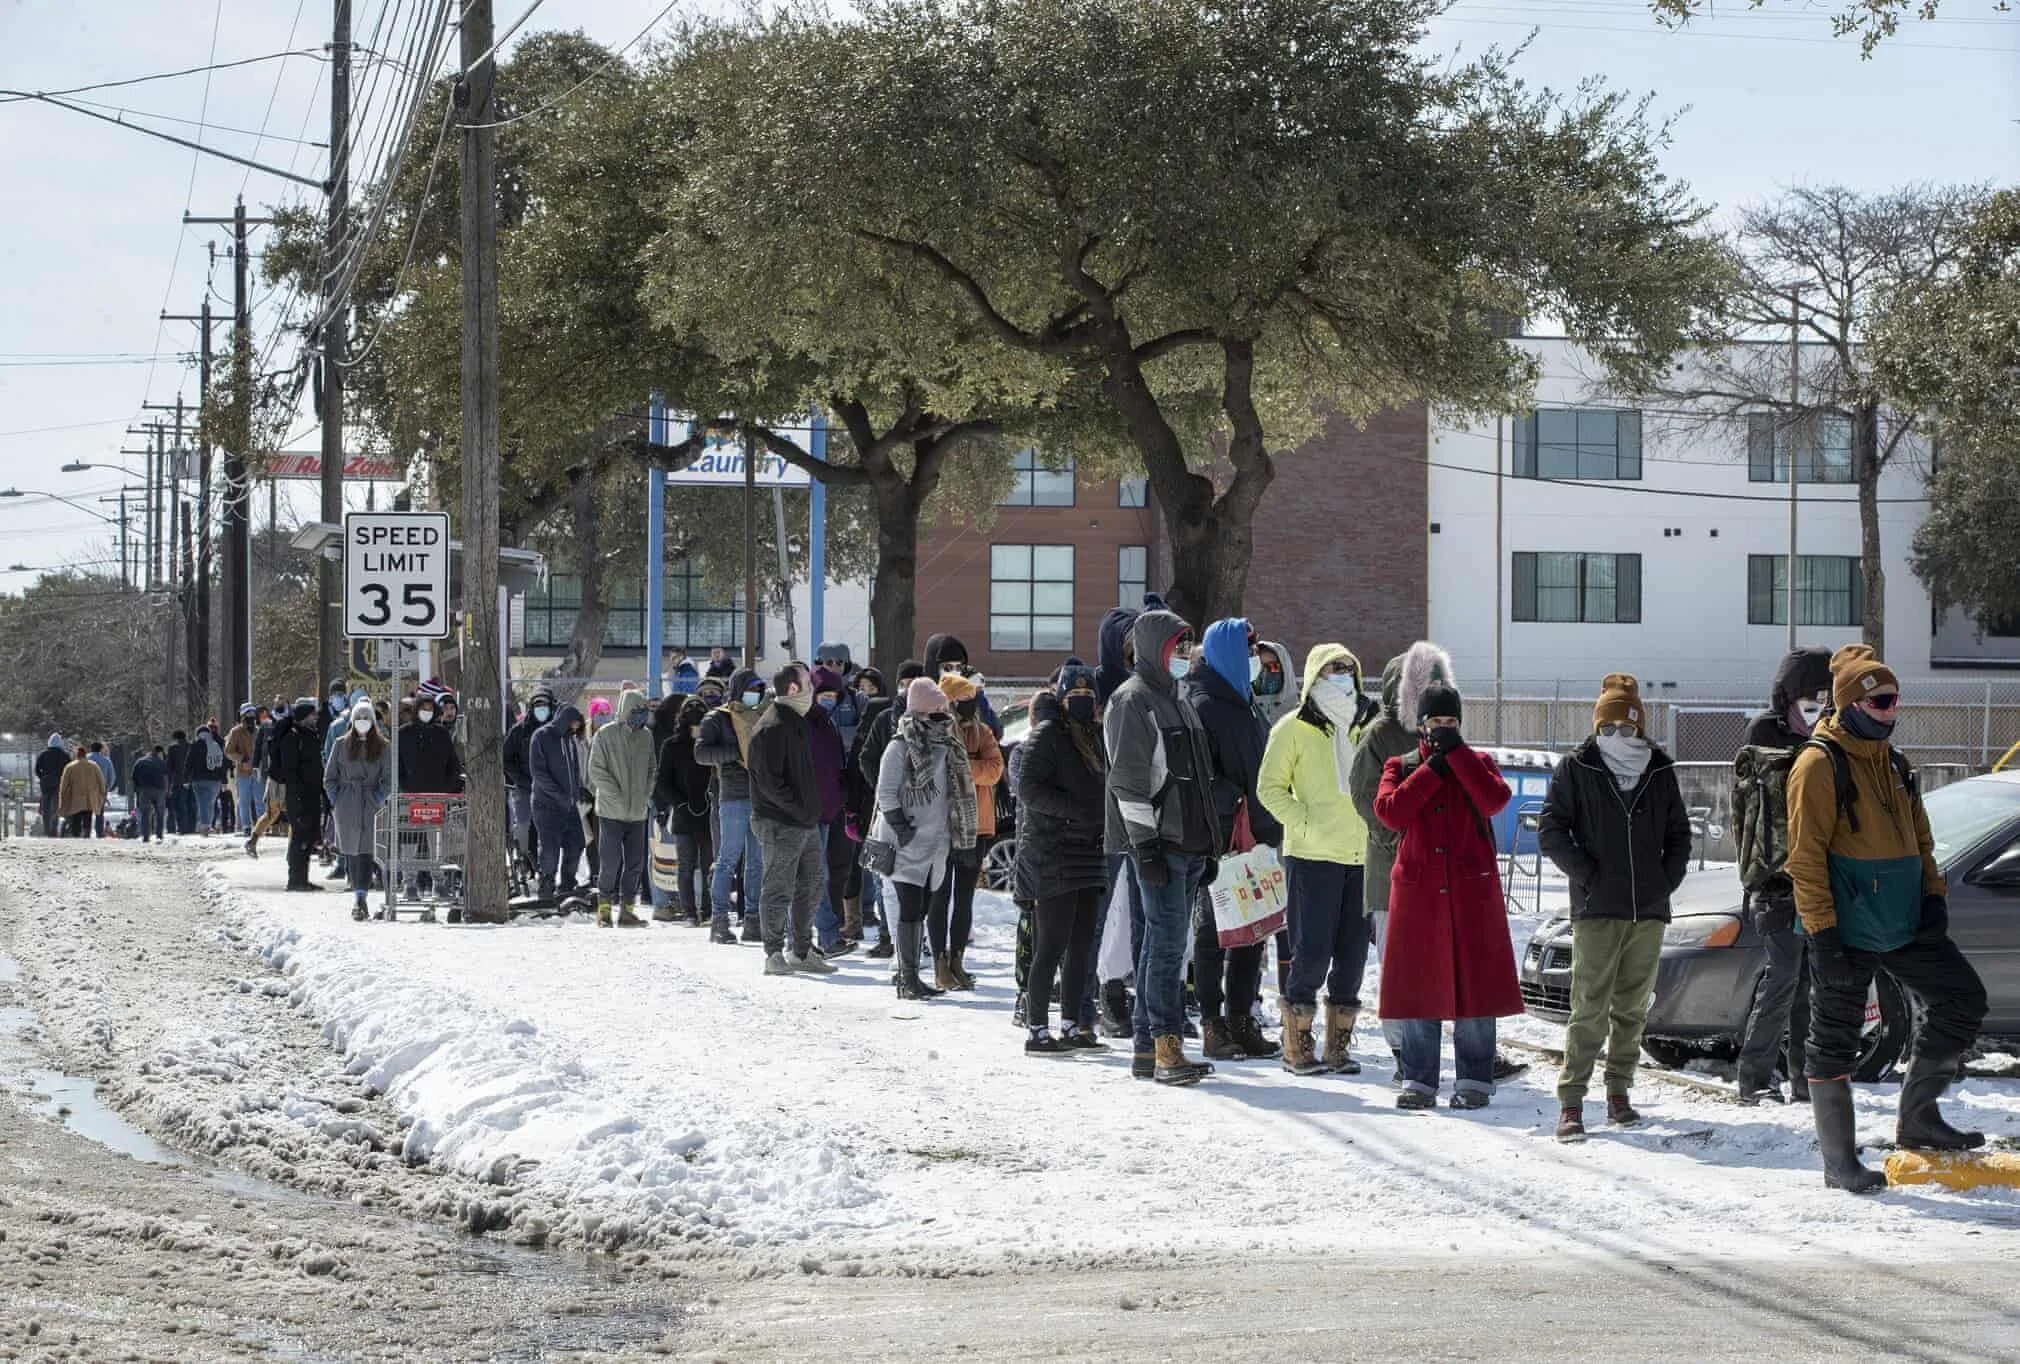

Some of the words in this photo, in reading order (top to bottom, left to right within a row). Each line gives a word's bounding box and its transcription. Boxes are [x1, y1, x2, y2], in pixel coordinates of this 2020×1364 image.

[295, 455, 395, 475] AuZone
[687, 453, 789, 479] aunry
[355, 526, 439, 545] SPEED
[364, 553, 430, 572] LIMIT
[357, 583, 436, 627] 35
